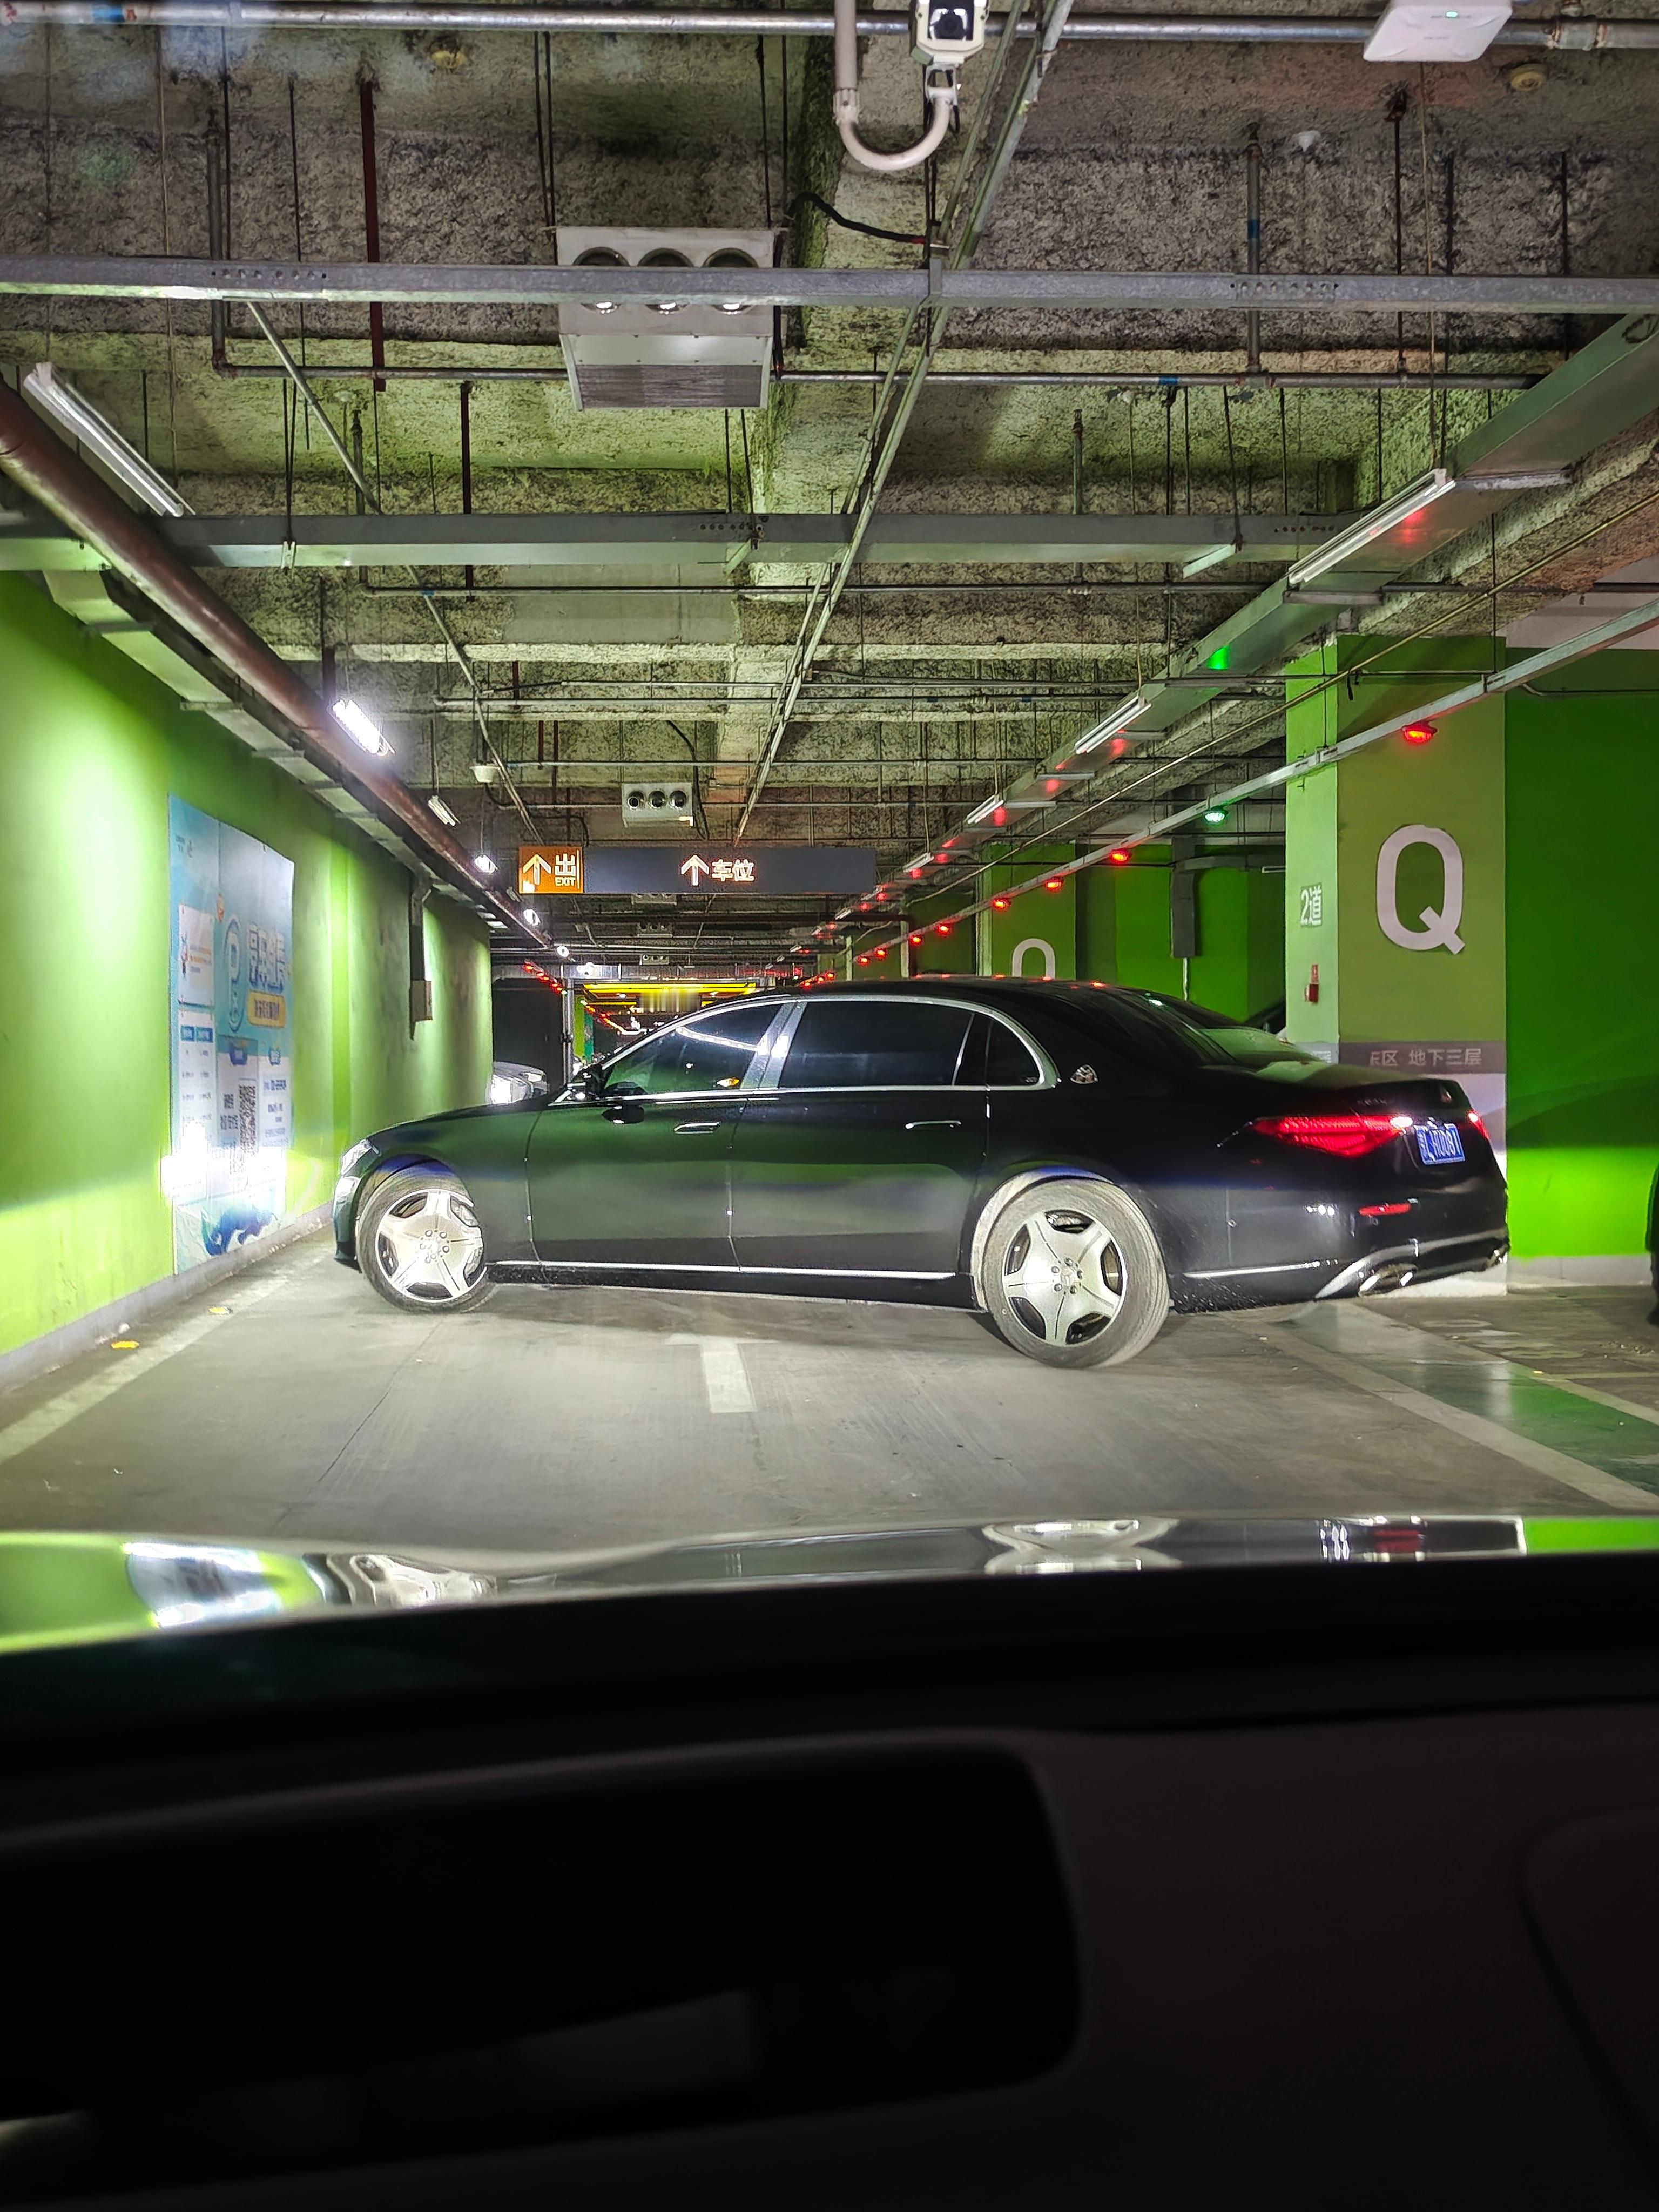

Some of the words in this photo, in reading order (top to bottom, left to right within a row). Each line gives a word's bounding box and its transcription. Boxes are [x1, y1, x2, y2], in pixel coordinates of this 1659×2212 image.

[555, 853, 576, 876] 出
[712, 859, 754, 881] 车位
[555, 876, 576, 886] EXIT
[1376, 824, 1466, 955] Q
[1300, 885, 1322, 926] 2道
[1408, 1048, 1482, 1067] 地下三层
